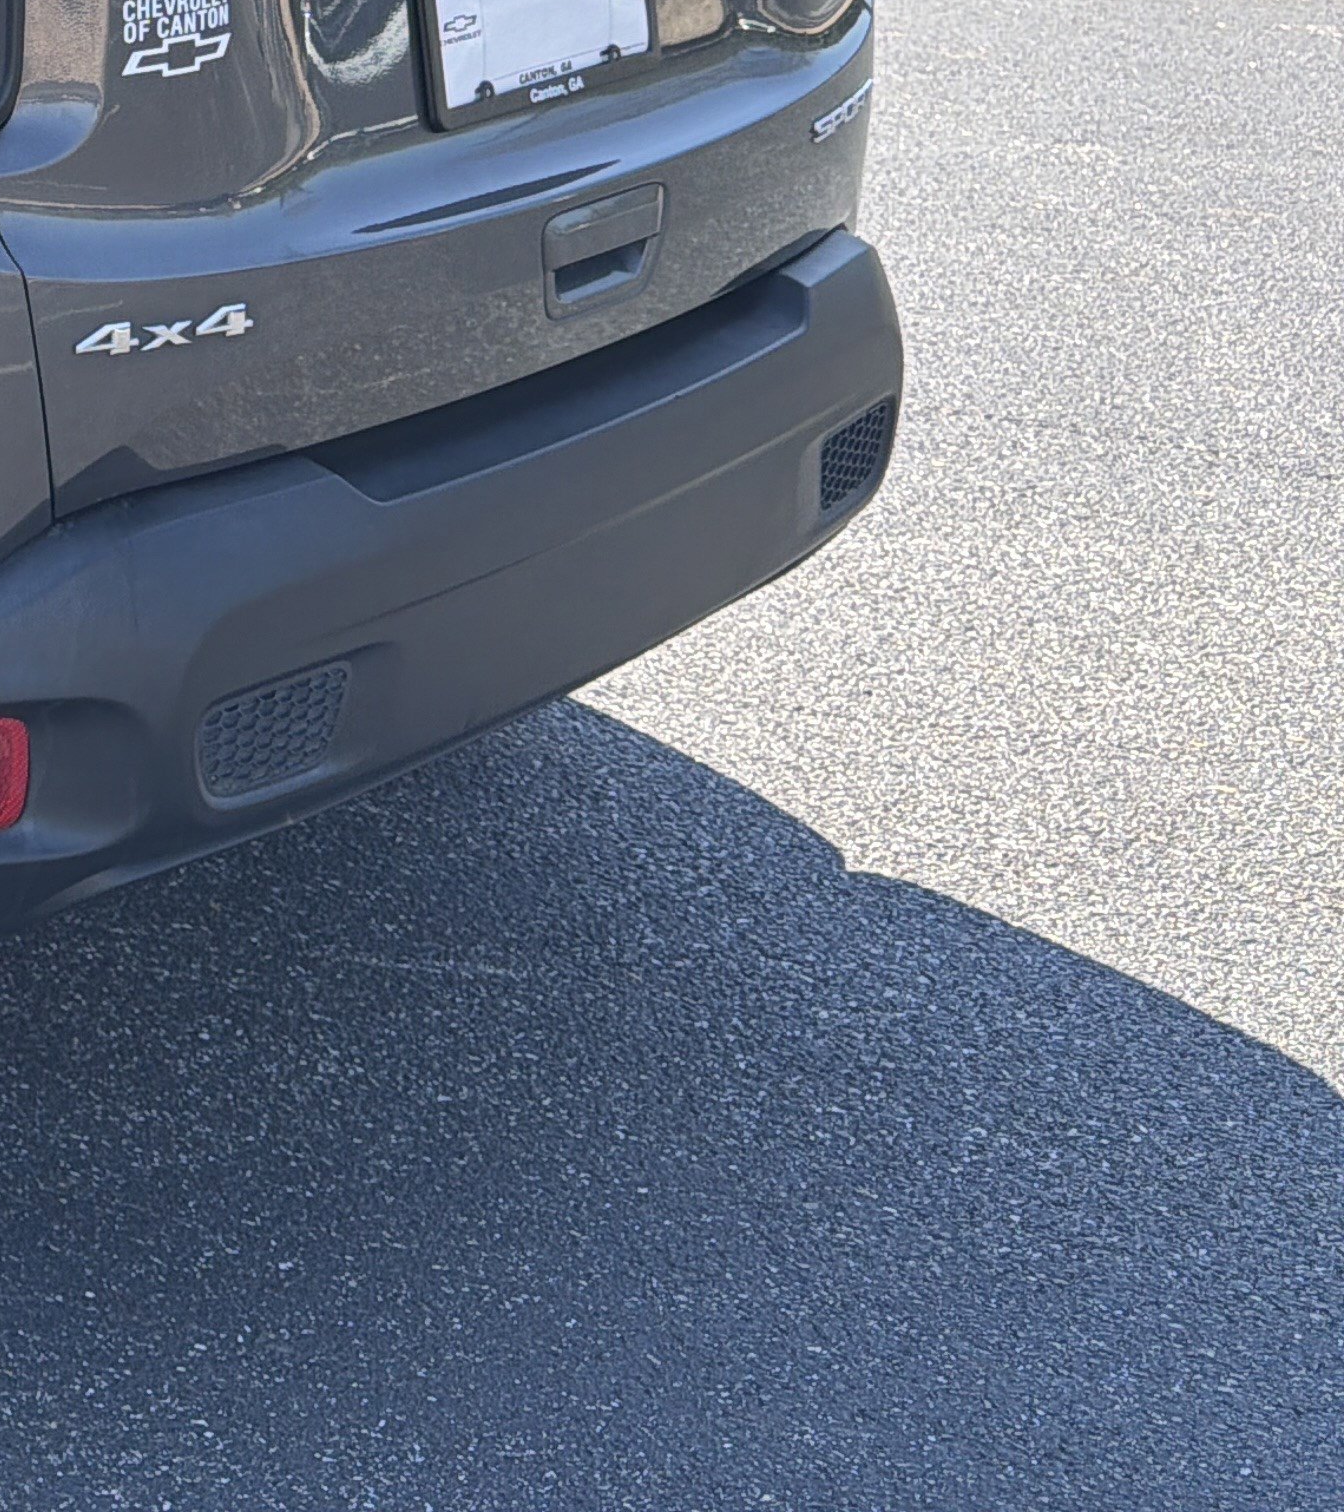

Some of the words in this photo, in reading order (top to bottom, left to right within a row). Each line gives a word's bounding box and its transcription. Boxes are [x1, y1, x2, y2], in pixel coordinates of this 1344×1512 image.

[123, 19, 151, 44] OF
[156, 3, 230, 39] CANTON
[568, 75, 585, 92] GA
[74, 302, 255, 356] 4x4
